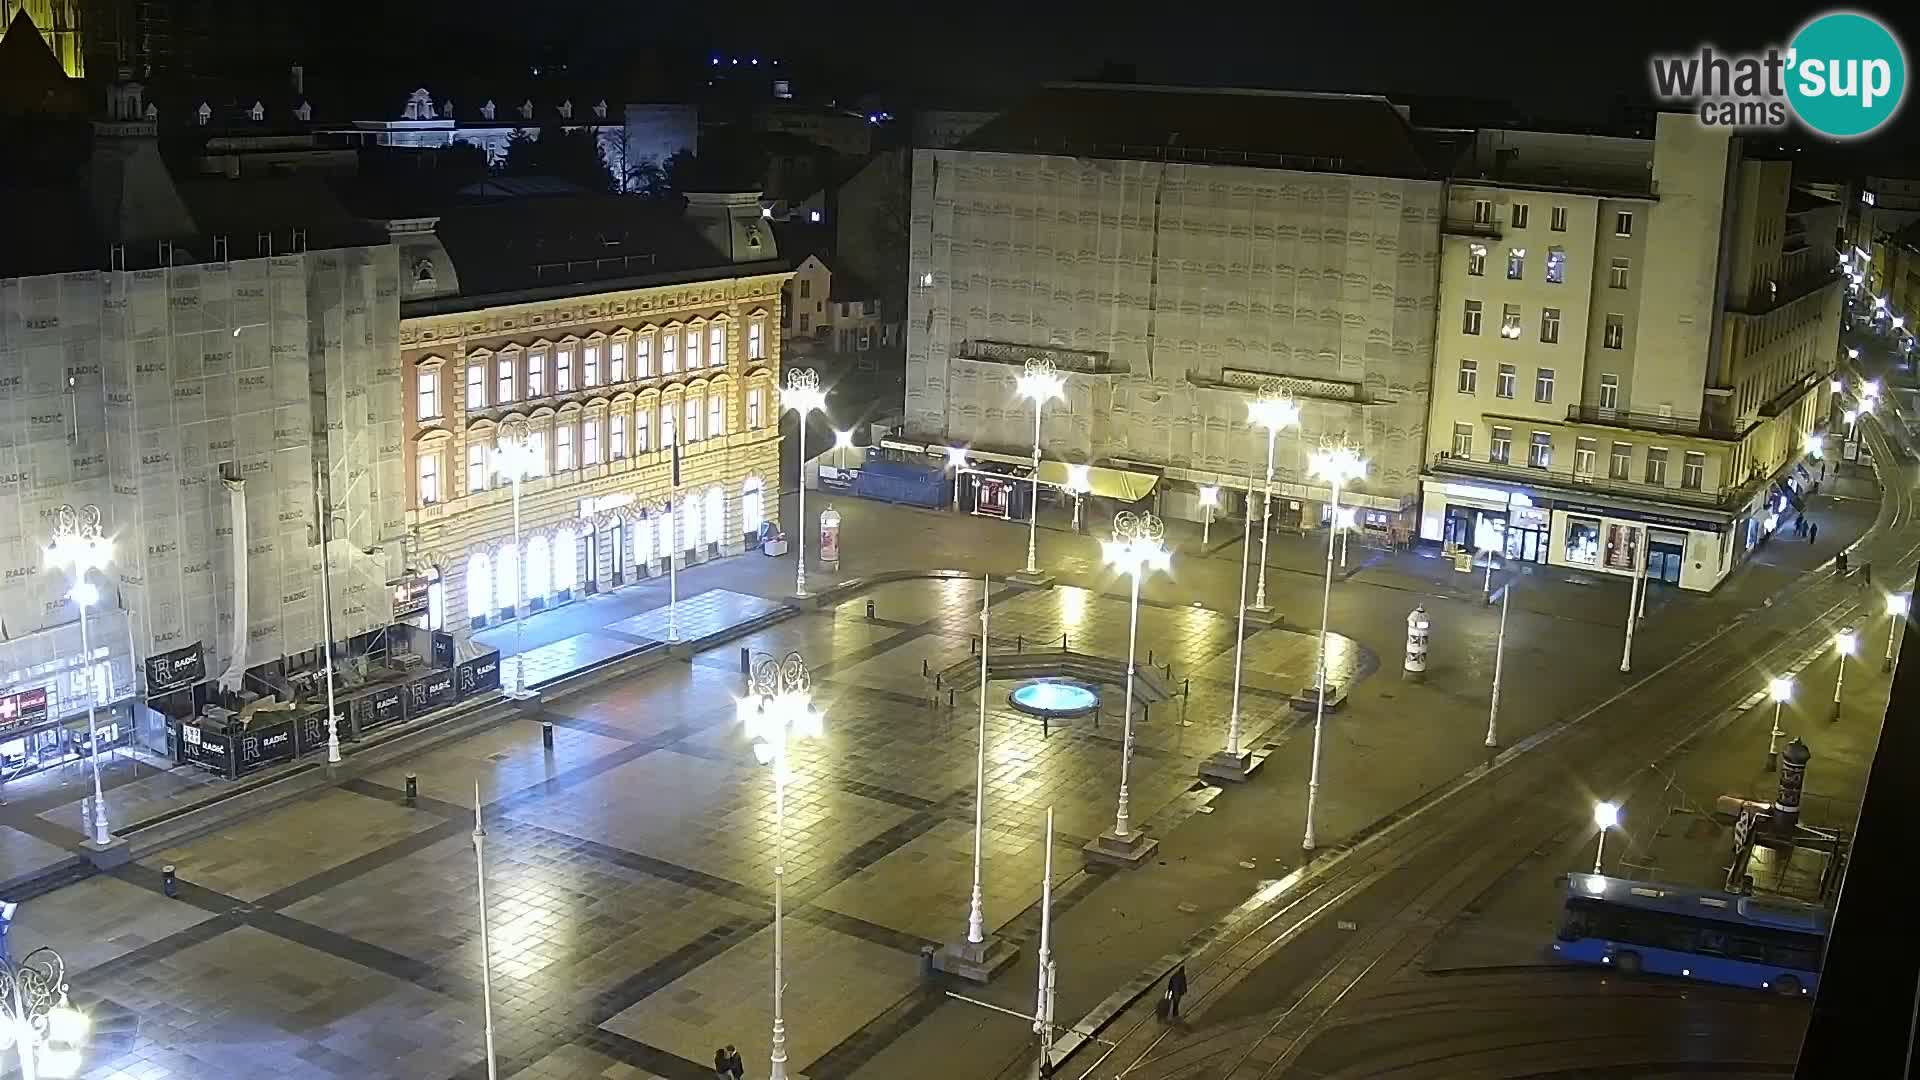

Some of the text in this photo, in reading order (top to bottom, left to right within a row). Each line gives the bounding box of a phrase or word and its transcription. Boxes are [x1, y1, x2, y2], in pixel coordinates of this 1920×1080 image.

[174, 652, 198, 669] RADIĆ
[263, 731, 288, 747] RADIĆ
[202, 741, 226, 755] RADIĆ
